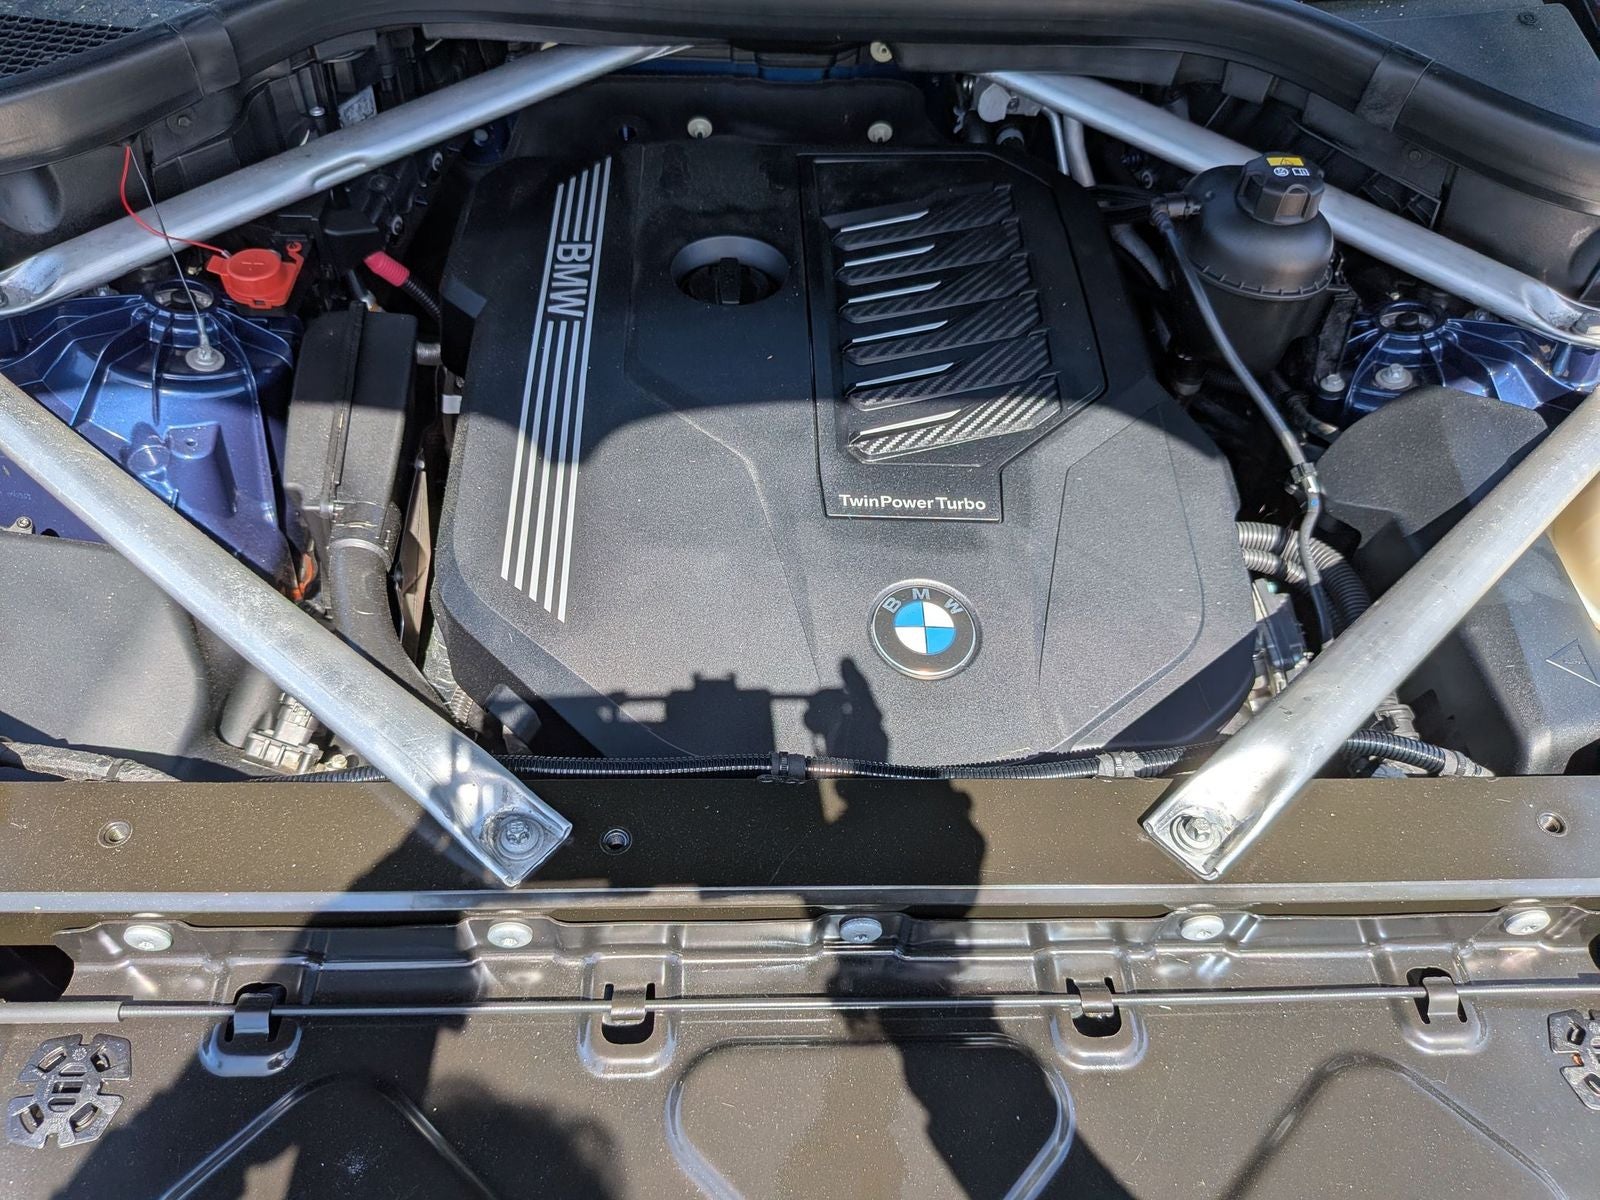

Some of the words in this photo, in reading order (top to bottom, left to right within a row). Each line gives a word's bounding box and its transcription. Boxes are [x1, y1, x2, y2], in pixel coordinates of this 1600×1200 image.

[547, 243, 593, 318] BMW
[838, 494, 934, 509] TwinPower
[935, 496, 986, 511] Turbo
[881, 588, 964, 615] BMW
